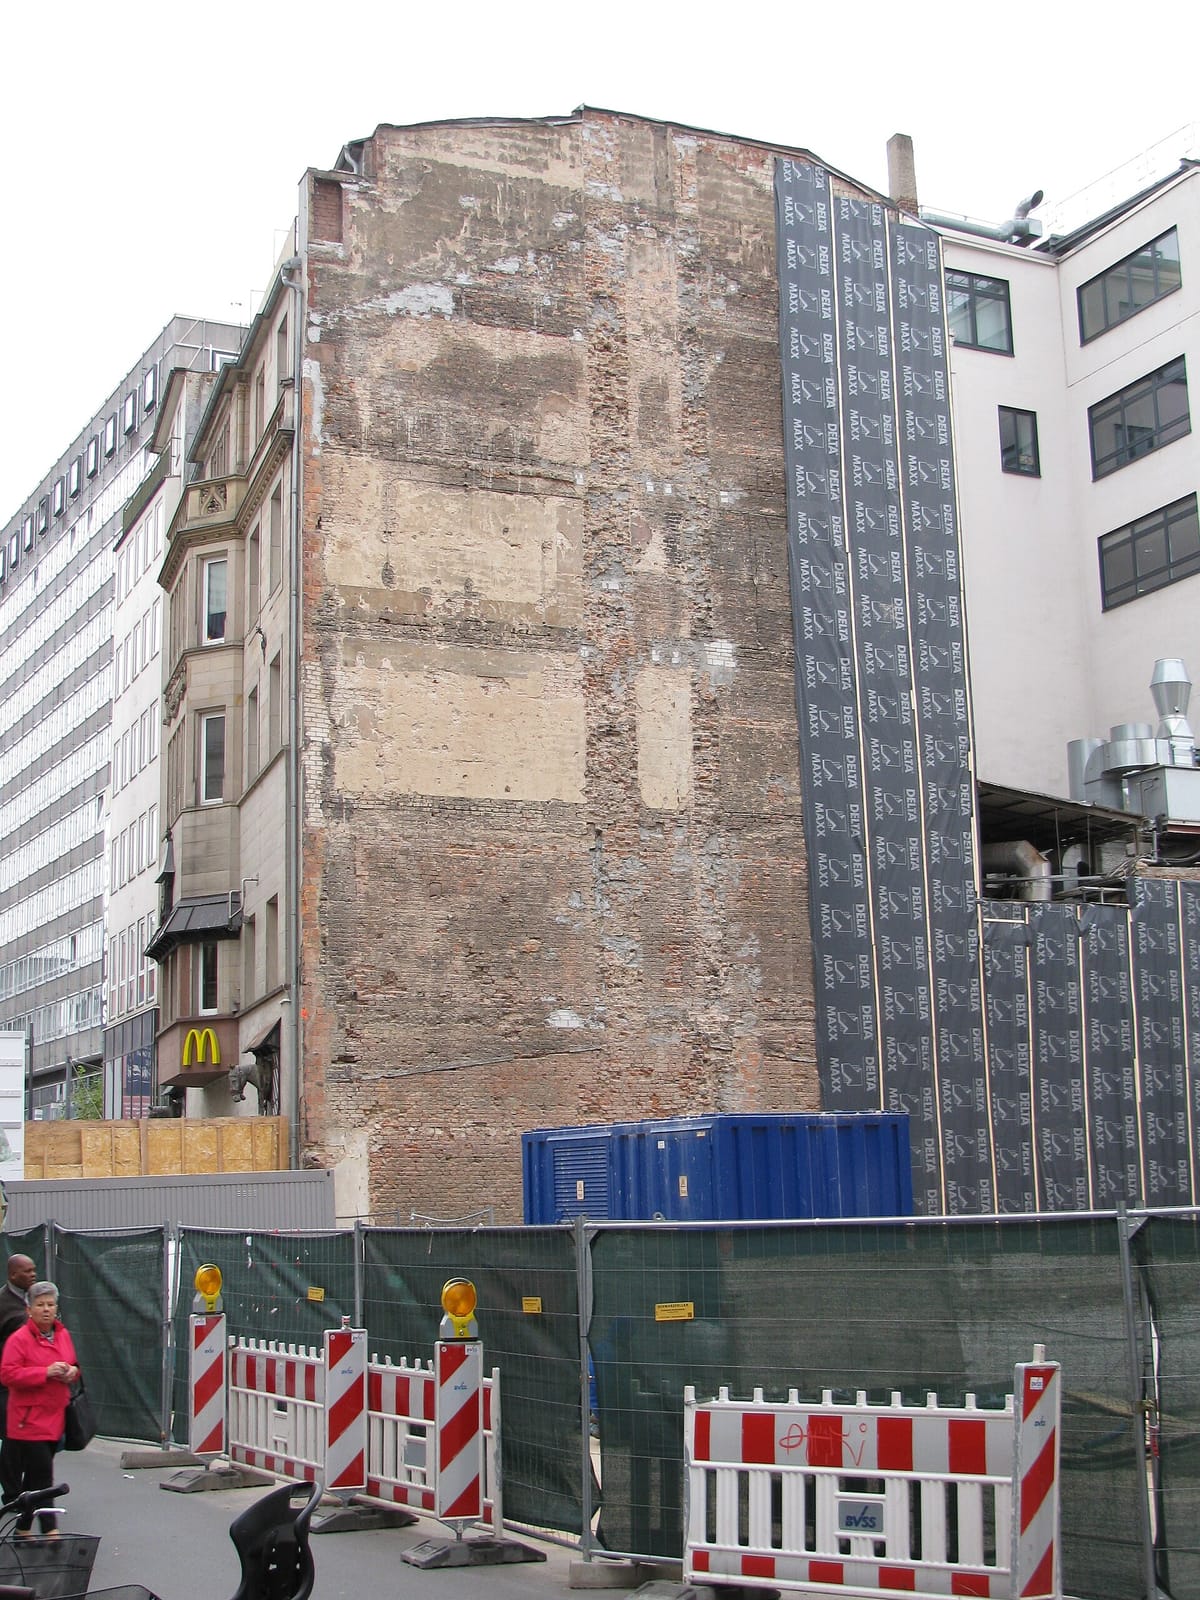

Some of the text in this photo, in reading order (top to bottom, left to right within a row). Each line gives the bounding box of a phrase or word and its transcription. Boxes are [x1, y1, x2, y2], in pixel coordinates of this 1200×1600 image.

[782, 160, 791, 183] AXX
[784, 197, 794, 225] MAXX
[817, 201, 827, 231] DELTA
[840, 198, 849, 221] AXX
[872, 204, 881, 227] ELTA
[787, 239, 797, 269] MAXX
[819, 245, 829, 275] DELTA
[842, 233, 850, 263] MAXX
[873, 240, 883, 270] DELTA
[897, 235, 906, 265] MAXX
[927, 241, 937, 271] DELTA
[789, 283, 798, 313] MAXX
[820, 289, 831, 320] DELTA
[844, 277, 853, 307] MAXX
[875, 283, 886, 313] DELTA
[899, 278, 908, 309] MAXX
[929, 284, 940, 314] DELTA
[790, 327, 799, 359] MAXX
[822, 333, 834, 365] DELTA
[846, 320, 855, 351] MAXX
[877, 327, 887, 357] DELTA
[901, 322, 910, 352] MAXX
[932, 327, 942, 357] DELTA
[791, 372, 801, 404] MAXX
[825, 378, 836, 409] DELTA
[848, 365, 857, 395] MAXX
[880, 371, 890, 401] DELTA
[902, 366, 912, 396] MAXX
[934, 371, 945, 402] DELTA
[793, 419, 803, 450] MAXX
[827, 423, 838, 455] DELTA
[850, 409, 860, 441] MAXX
[882, 415, 892, 446] DELTA
[905, 410, 916, 441] MAXX
[937, 415, 947, 446] DELTA
[795, 465, 805, 497] MAXX
[829, 470, 840, 501] DELTA
[852, 455, 862, 486] MAXX
[885, 460, 895, 491] DELTA
[908, 455, 918, 486] MAXX
[940, 460, 951, 490] DELTA
[797, 512, 808, 544] MAXX
[831, 516, 842, 547] DELTA
[855, 501, 865, 533] MAXX
[887, 505, 898, 536] DELTA
[911, 501, 922, 532] MAXX
[943, 505, 954, 536] DELTA
[800, 559, 810, 592] MAXX
[834, 562, 845, 594] DELTA
[858, 548, 868, 580] MAXX
[890, 551, 901, 583] DELTA
[914, 546, 924, 578] MAXX
[945, 550, 956, 581] DELTA
[803, 607, 814, 640] MAXX
[861, 594, 872, 627] MAXX
[893, 598, 904, 630] DELTA
[917, 592, 927, 624] MAXX
[948, 596, 959, 627] DELTA
[837, 610, 848, 641] DELTA
[805, 655, 816, 689] MAXX
[864, 642, 874, 675] MAXX
[897, 645, 908, 677] DELTA
[919, 640, 929, 672] MAXX
[952, 643, 962, 674] DELTA
[840, 658, 852, 691] DELTA
[867, 689, 878, 722] MAXX
[900, 693, 911, 725] DELTA
[921, 687, 932, 719] MAXX
[954, 689, 966, 721] DELTA
[808, 704, 819, 737] MAXX
[843, 707, 855, 739] DELTA
[870, 738, 880, 771] MAXX
[902, 740, 914, 773] DELTA
[925, 734, 935, 767] MAXX
[958, 736, 967, 768] DELTA
[811, 753, 823, 787] MAXX
[846, 755, 857, 788] DELTA
[873, 787, 883, 820] MAXX
[905, 789, 917, 822] DELTA
[928, 782, 938, 815] MAXX
[960, 784, 970, 816] DELTA
[815, 802, 826, 837] MAXX
[849, 805, 861, 838] DELTA
[876, 836, 886, 870] MAXX
[908, 837, 919, 871] DELTA
[930, 831, 941, 864] MAXX
[963, 832, 972, 864] DELTA
[818, 853, 829, 888] MAXX
[852, 854, 864, 888] DELTA
[878, 886, 889, 920] MAXX
[911, 887, 922, 920] DELTA
[933, 880, 942, 913] MAXX
[820, 904, 831, 938] MAXX
[856, 904, 867, 938] DELTA
[881, 936, 892, 970] MAXX
[914, 937, 925, 970] DELTA
[934, 929, 945, 962] MAXX
[967, 929, 976, 962] DELTA
[823, 955, 835, 989] MAXX
[859, 955, 870, 989] DELTA
[884, 986, 894, 1020] MAXX
[917, 987, 928, 1020] DELTA
[937, 978, 948, 1012] MAXX
[970, 979, 981, 1012] DELTA
[826, 1006, 838, 1041] MAXX
[862, 1006, 873, 1040] DELTA
[886, 1037, 897, 1072] MAXX
[940, 1028, 950, 1063] MAXX
[973, 1028, 984, 1062] DELTA
[830, 1058, 841, 1093] MAXX
[865, 1057, 876, 1091] DELTA
[922, 1088, 934, 1121] DELTA
[941, 1079, 952, 1113] MAXX
[975, 1078, 986, 1112] DELTA
[924, 1138, 936, 1173] DELTA
[945, 1129, 955, 1164] MAXX
[978, 1129, 988, 1162] DELTA
[947, 1181, 958, 1215] MAXX
[980, 1180, 991, 1213] DELTA
